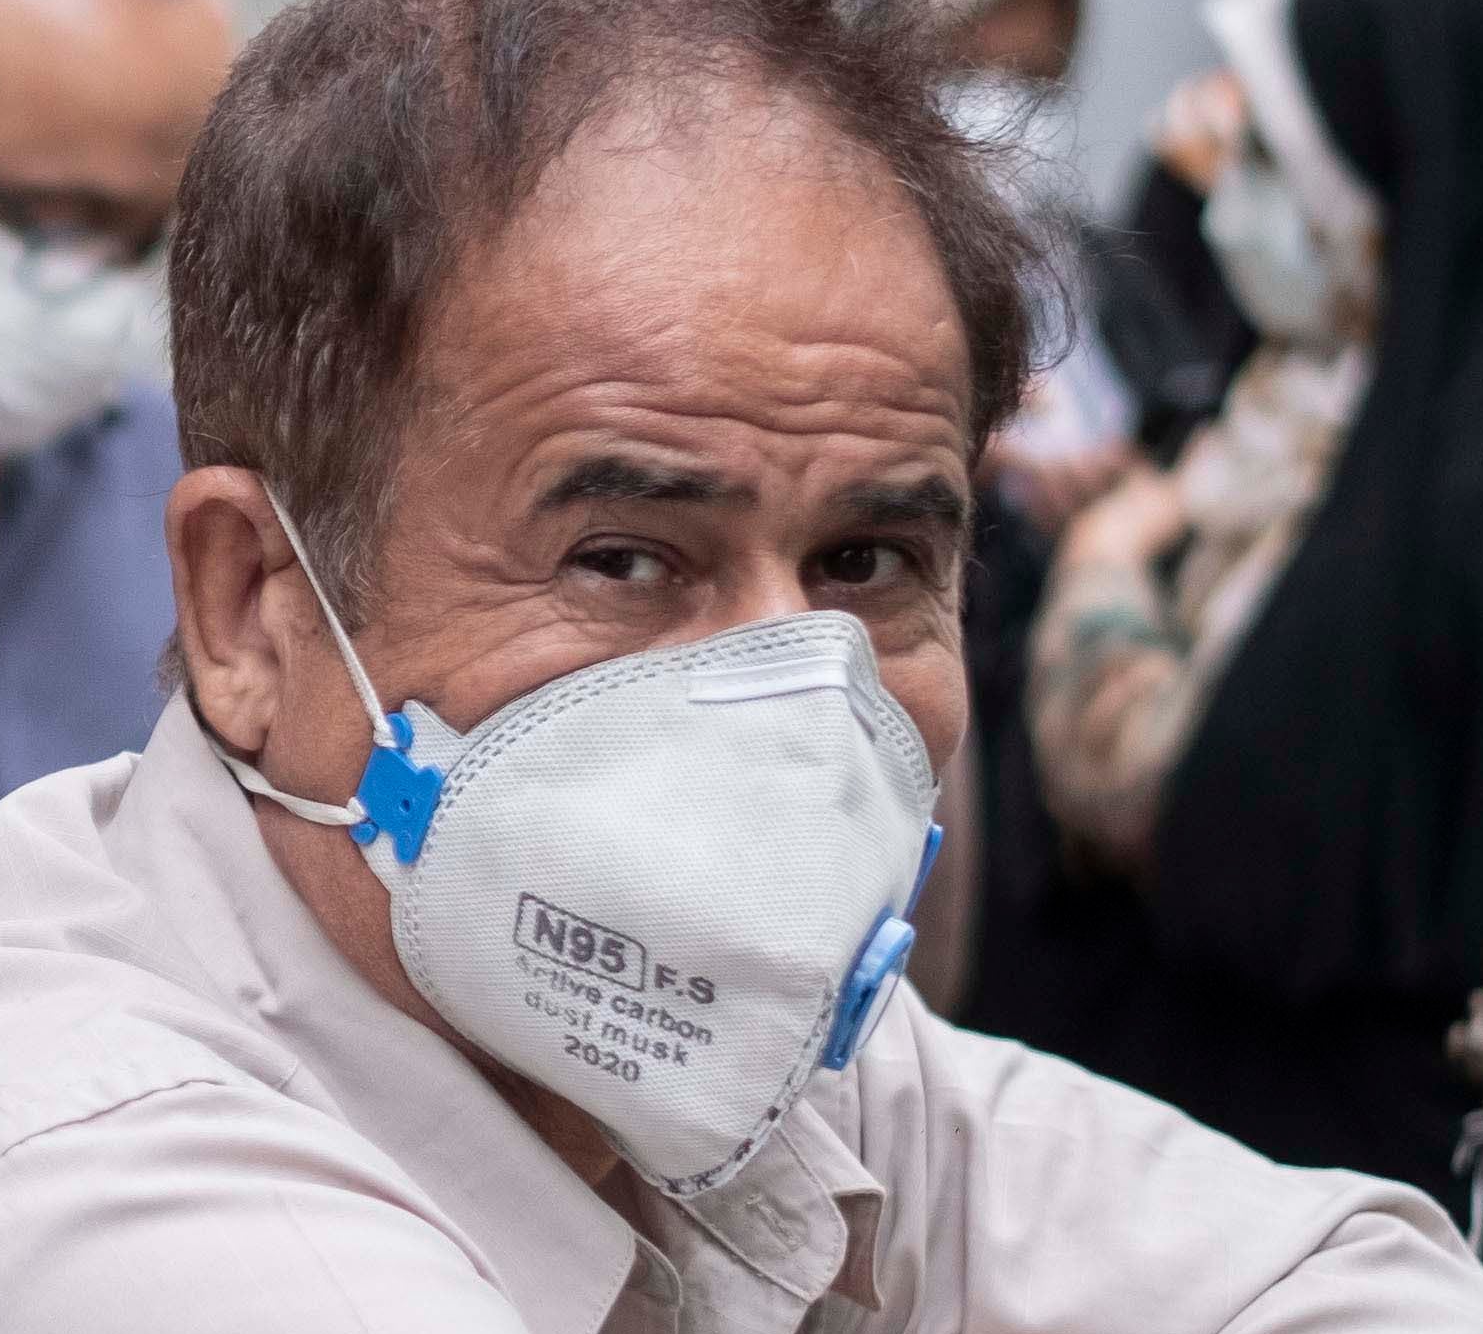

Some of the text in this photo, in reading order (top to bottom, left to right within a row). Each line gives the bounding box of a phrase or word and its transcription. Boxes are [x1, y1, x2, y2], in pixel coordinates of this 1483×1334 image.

[535, 908, 715, 1005] N95 F.S
[601, 1020, 690, 1067] musk
[611, 994, 713, 1044] carbon
[564, 1034, 641, 1082] 2020
